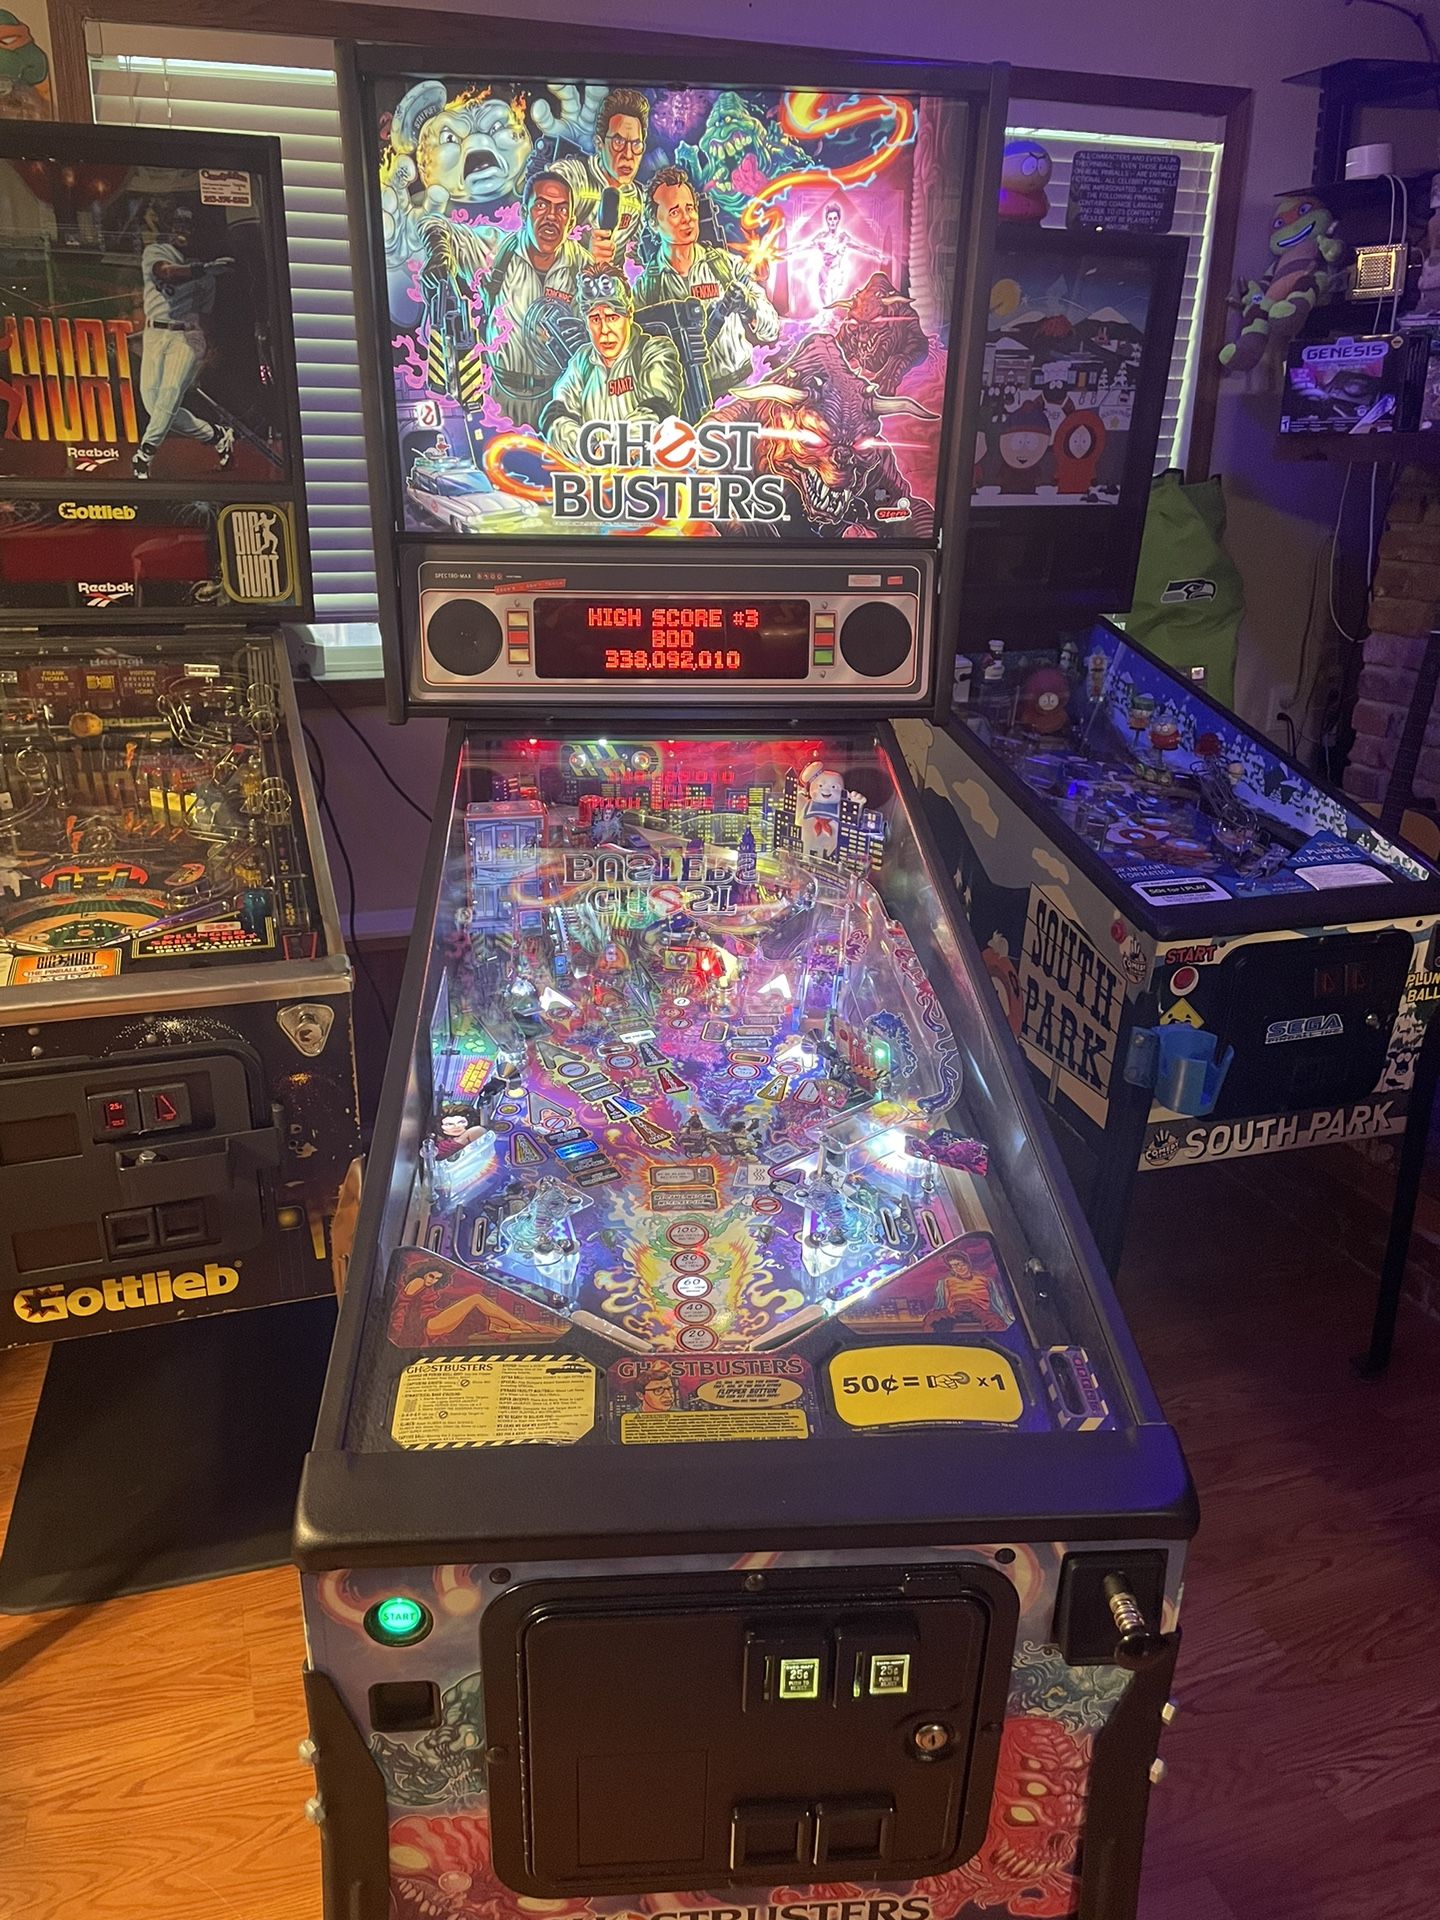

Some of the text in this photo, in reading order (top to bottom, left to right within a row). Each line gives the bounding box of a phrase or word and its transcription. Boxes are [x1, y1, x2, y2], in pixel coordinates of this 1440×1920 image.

[1306, 344, 1384, 360] GENESIS
[579, 416, 760, 470] GHOST
[67, 447, 120, 458] Reebok
[551, 473, 787, 521] BUSTERS
[58, 502, 136, 520] Gottlieb
[878, 509, 910, 518] Stern
[235, 554, 280, 597] HURT
[78, 582, 134, 593] Reebok
[588, 608, 759, 628] HIGH SCORE #3
[605, 650, 740, 670] 338,092,010
[1305, 846, 1353, 855] PLUNGER
[1334, 853, 1361, 861] BALL
[1165, 945, 1217, 965] START
[1032, 899, 1117, 1031] SOUTH
[44, 968, 78, 976] PINBALL
[1406, 985, 1440, 1004] BALL
[1268, 1013, 1344, 1037] SEGA
[1022, 975, 1107, 1090] PARK
[1184, 1100, 1394, 1159] SOUTH PARK
[677, 1226, 698, 1234] 100
[683, 1278, 701, 1286] 60
[13, 1263, 240, 1323] Gottlieb
[686, 1303, 703, 1311] 40
[688, 1330, 706, 1338] 20
[406, 1363, 494, 1374] GHOSTBUSTERS
[717, 1387, 748, 1395] FLIPPER
[383, 1612, 416, 1621] START
[789, 1669, 809, 1680] 25¢
[880, 1665, 899, 1676] 25¢
